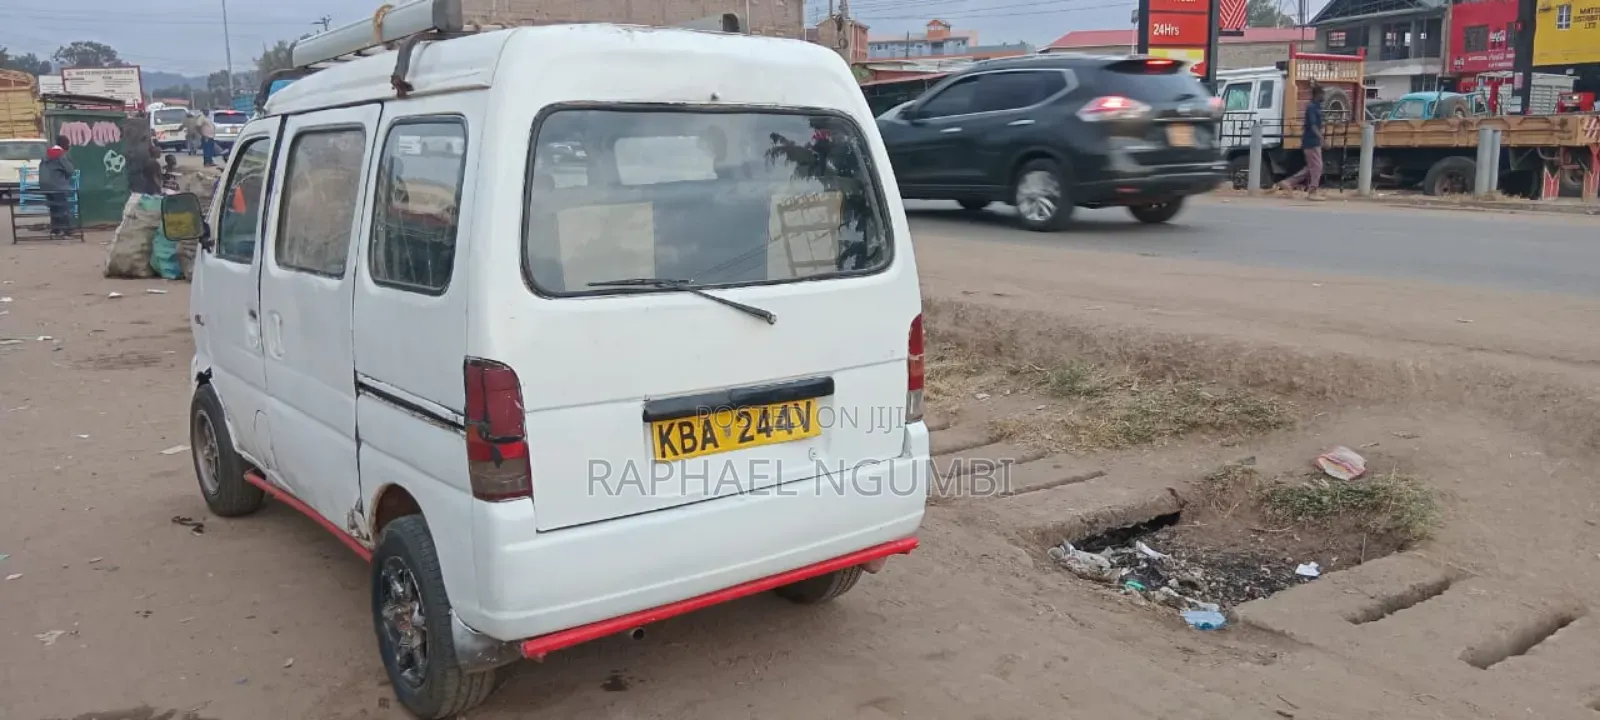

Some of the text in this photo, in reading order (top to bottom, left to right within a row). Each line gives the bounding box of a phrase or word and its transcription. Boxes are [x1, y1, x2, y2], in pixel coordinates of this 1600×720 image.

[1153, 23, 1180, 36] 24Hrs
[657, 401, 812, 459] KBA 244V
